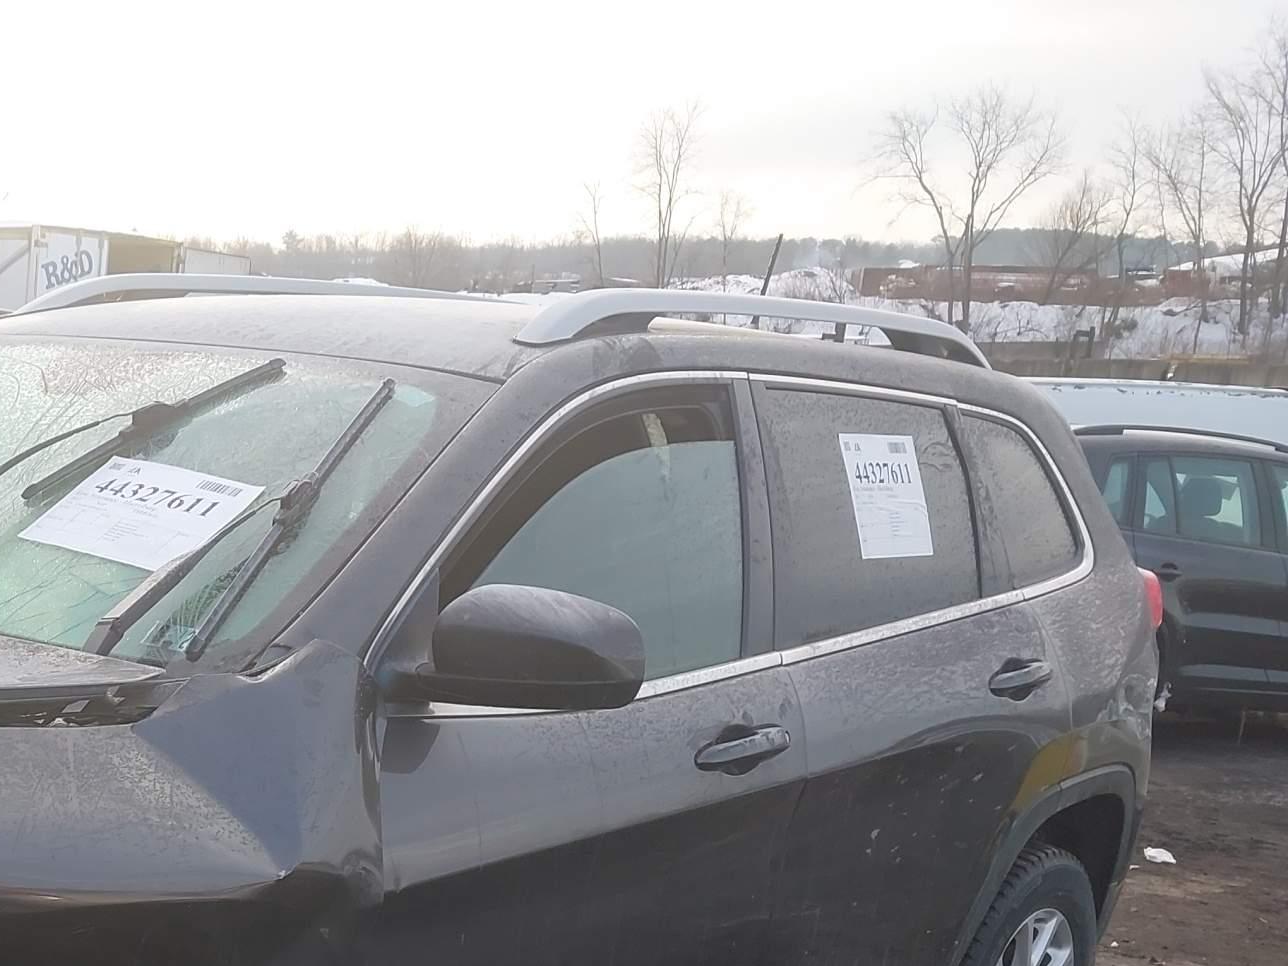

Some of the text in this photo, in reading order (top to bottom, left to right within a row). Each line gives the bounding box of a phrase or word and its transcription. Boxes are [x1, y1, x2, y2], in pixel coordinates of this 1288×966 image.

[41, 249, 93, 289] R&D
[855, 461, 912, 484] 44327611
[95, 478, 220, 517] 44327611
